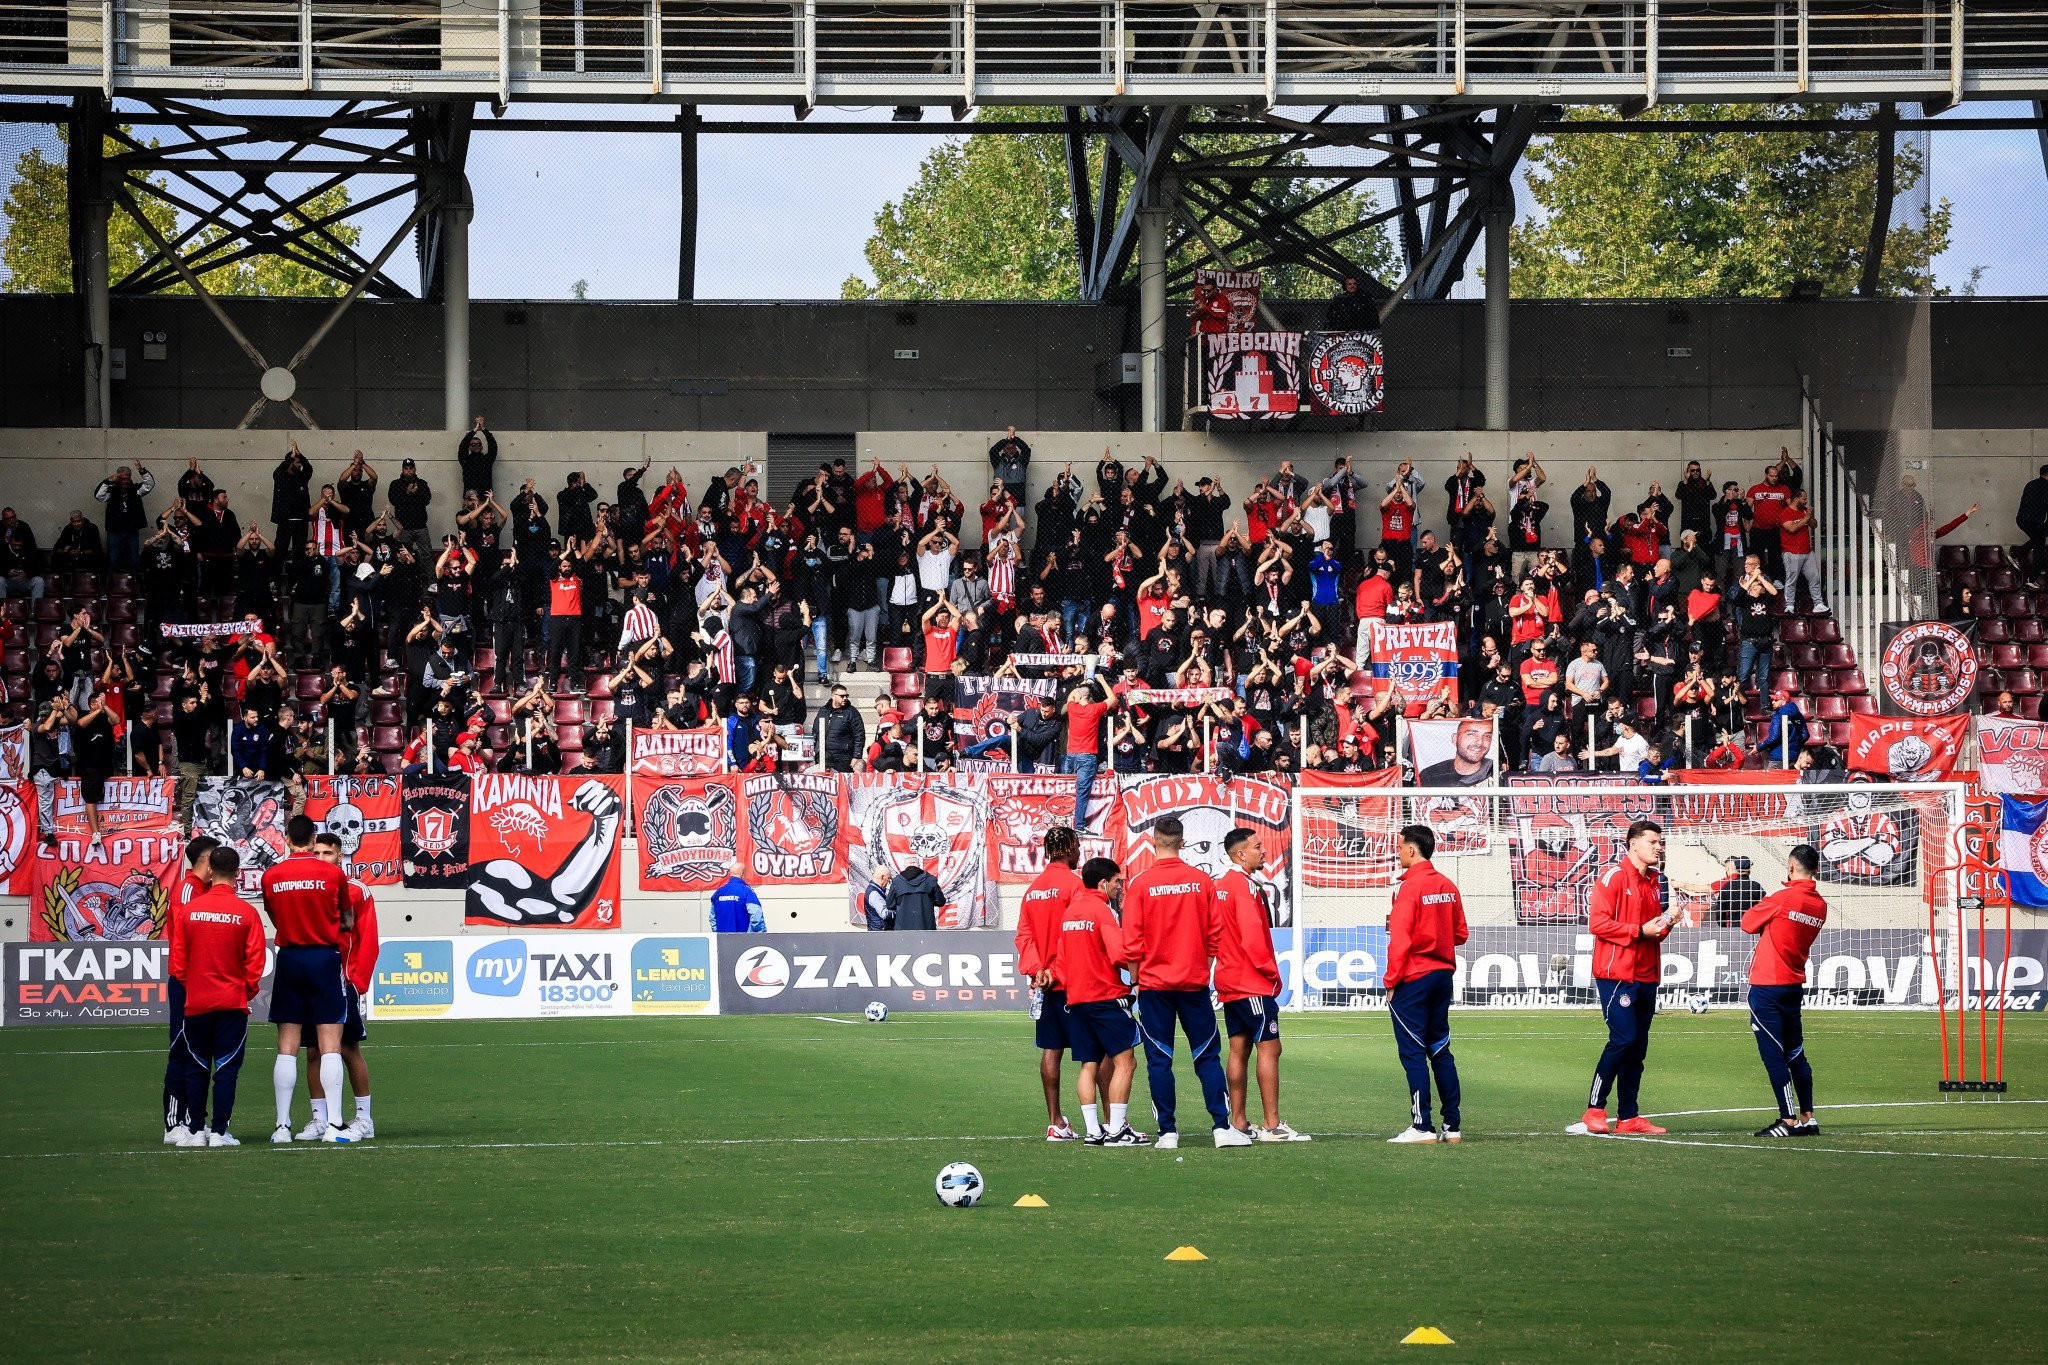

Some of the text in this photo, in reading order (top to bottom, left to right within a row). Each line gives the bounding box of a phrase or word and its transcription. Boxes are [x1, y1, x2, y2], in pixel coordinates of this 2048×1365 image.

[1208, 332, 1301, 357] ΜΕΘΩΝΗ
[1321, 369, 1334, 381] 19
[1373, 621, 1457, 654] PREVEZA
[1395, 662, 1438, 681] 1995
[634, 733, 721, 760] ΑΛΙΜΟΣ
[472, 774, 564, 820] KAMINIA
[689, 801, 696, 811] 7
[368, 821, 387, 833] 92
[427, 817, 444, 840] 7
[423, 840, 447, 849] REDS
[660, 849, 731, 867] ΗΛΙΟΥΠΟΛΗ
[753, 849, 835, 877] ΘΥΡΑ 7
[272, 880, 315, 893] OLYMPIACOS
[315, 880, 326, 891] FC
[1149, 882, 1201, 897] OLYMPIACOS FC
[190, 911, 242, 925] OLYMPIACOS FC
[378, 971, 449, 986] LEMON
[474, 953, 612, 986] my TAXI
[636, 968, 705, 982] LEMON
[794, 953, 1031, 989] ZAKCRE
[404, 986, 449, 996] taxi app
[538, 984, 613, 1003] 18300
[661, 982, 706, 994] taxi app
[1489, 988, 1568, 1008] novibet
